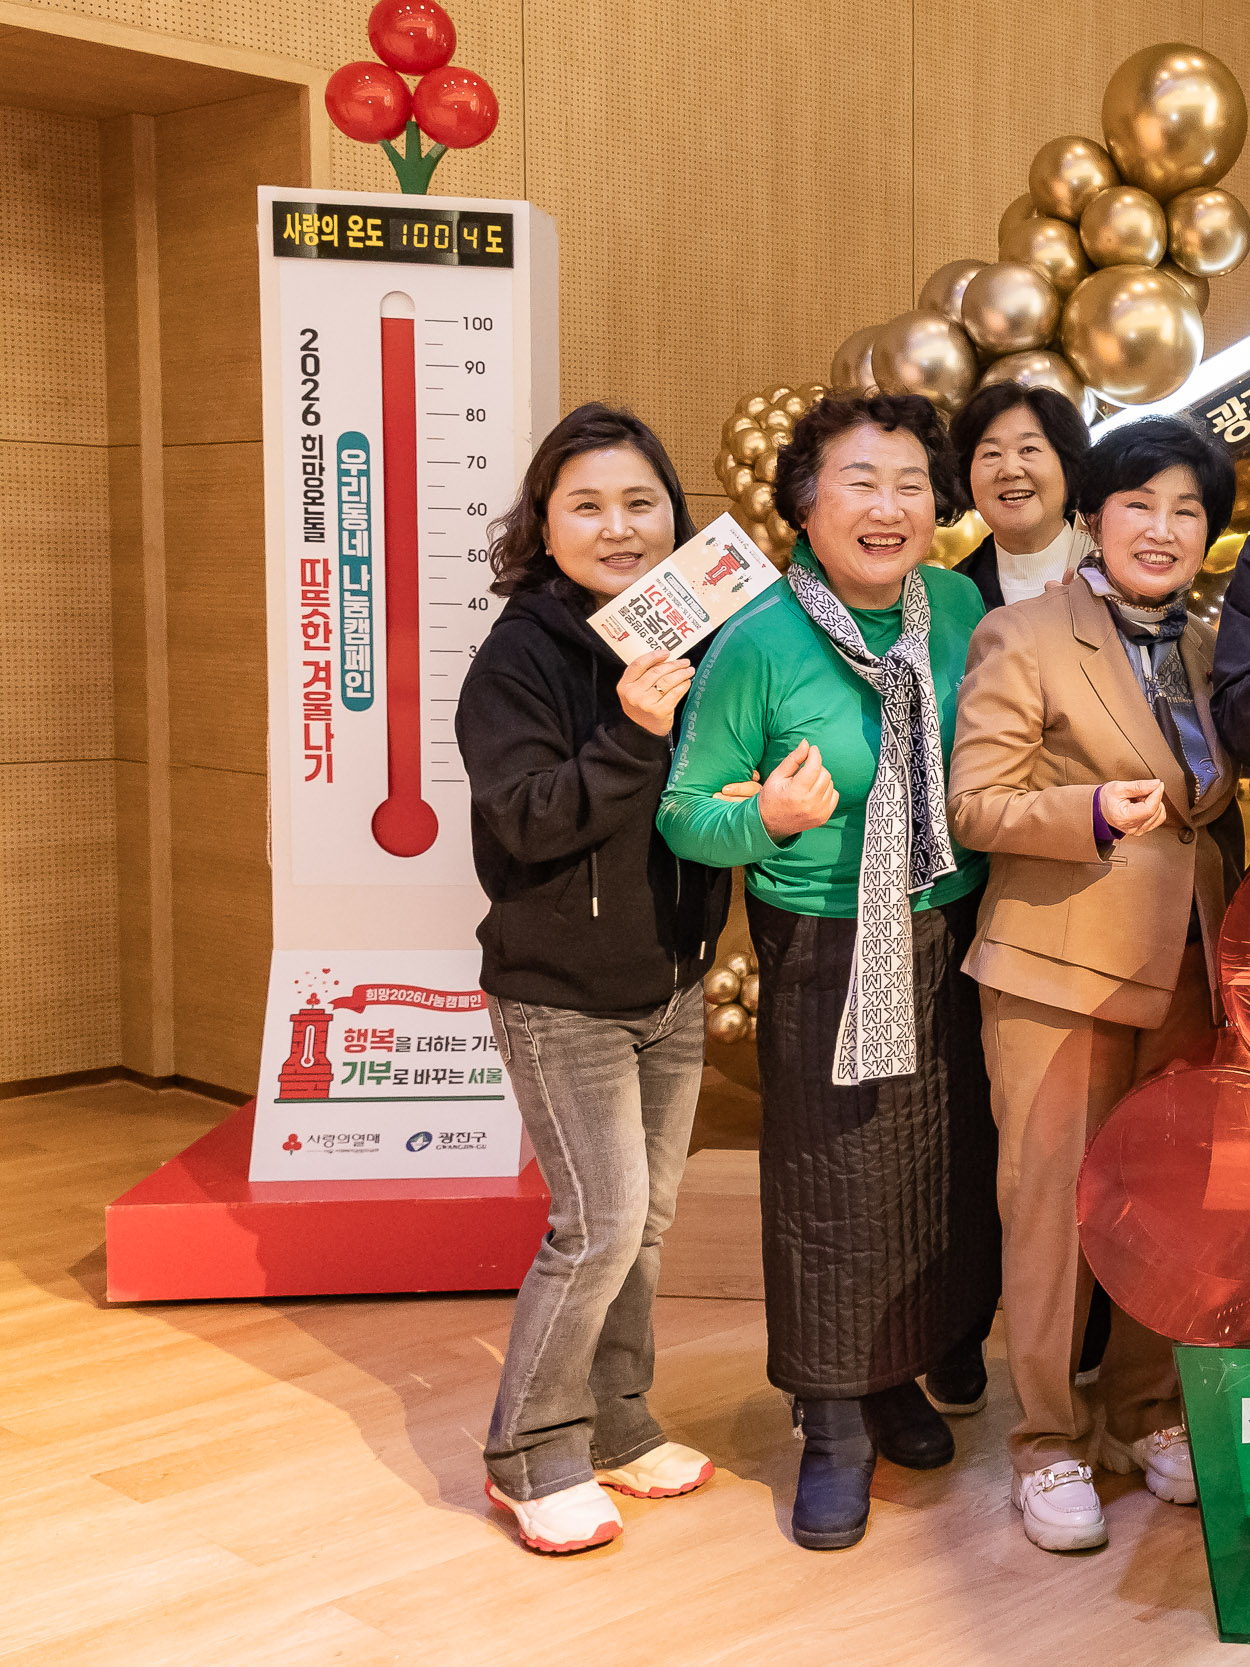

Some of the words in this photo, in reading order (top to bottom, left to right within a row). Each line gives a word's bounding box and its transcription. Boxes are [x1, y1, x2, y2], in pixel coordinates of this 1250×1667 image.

[283, 212, 338, 247] 사랑의
[346, 215, 384, 248] 온도
[485, 225, 504, 254] 도
[463, 316, 493, 331] 100
[299, 328, 322, 426] 2026
[464, 360, 486, 375] 90
[465, 408, 486, 422] 80
[466, 456, 487, 470] 70
[301, 433, 326, 543] 희망온돌
[340, 449, 370, 557] 우리동네
[466, 503, 487, 516] 60
[467, 549, 488, 563] 50
[300, 558, 332, 651] 따뜻한
[467, 598, 488, 611] 40
[644, 584, 695, 639] 겨울나기
[343, 565, 371, 699] 나눔캠페인
[628, 594, 683, 651] 따뜻한
[302, 660, 335, 783] 겨울나기
[365, 988, 482, 1008] 희망2026나눔캠페인
[343, 1028, 412, 1054] 행복을
[417, 1035, 467, 1053] 더하는
[340, 1061, 409, 1086] 기부로
[413, 1068, 464, 1085] 바꾸는
[468, 1067, 503, 1085] 서울
[438, 1131, 487, 1144] 광진구
